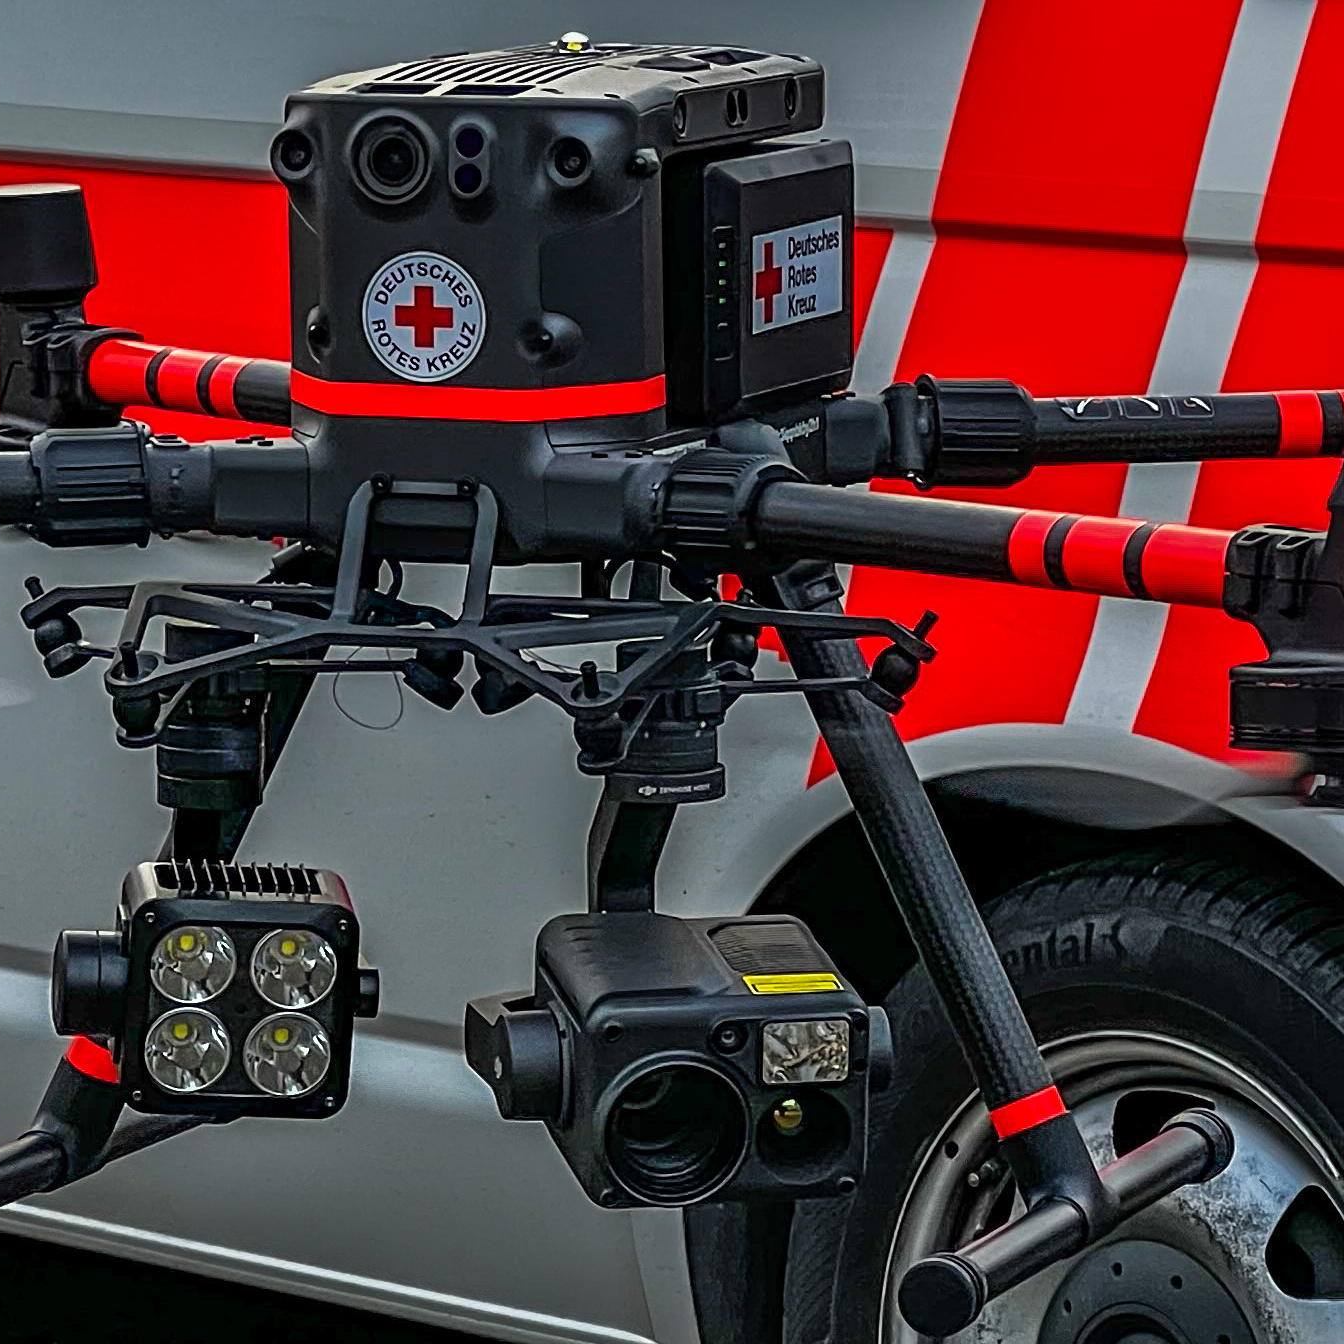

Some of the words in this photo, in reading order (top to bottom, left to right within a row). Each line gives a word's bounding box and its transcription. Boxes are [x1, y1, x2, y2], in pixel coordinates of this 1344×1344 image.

[788, 228, 839, 260] Deutsches
[374, 262, 472, 308] DEUTSCHES
[788, 264, 816, 288] Rotes
[788, 294, 817, 318] Kreuz
[372, 319, 420, 371] ROTES
[426, 322, 476, 372] KREUZ
